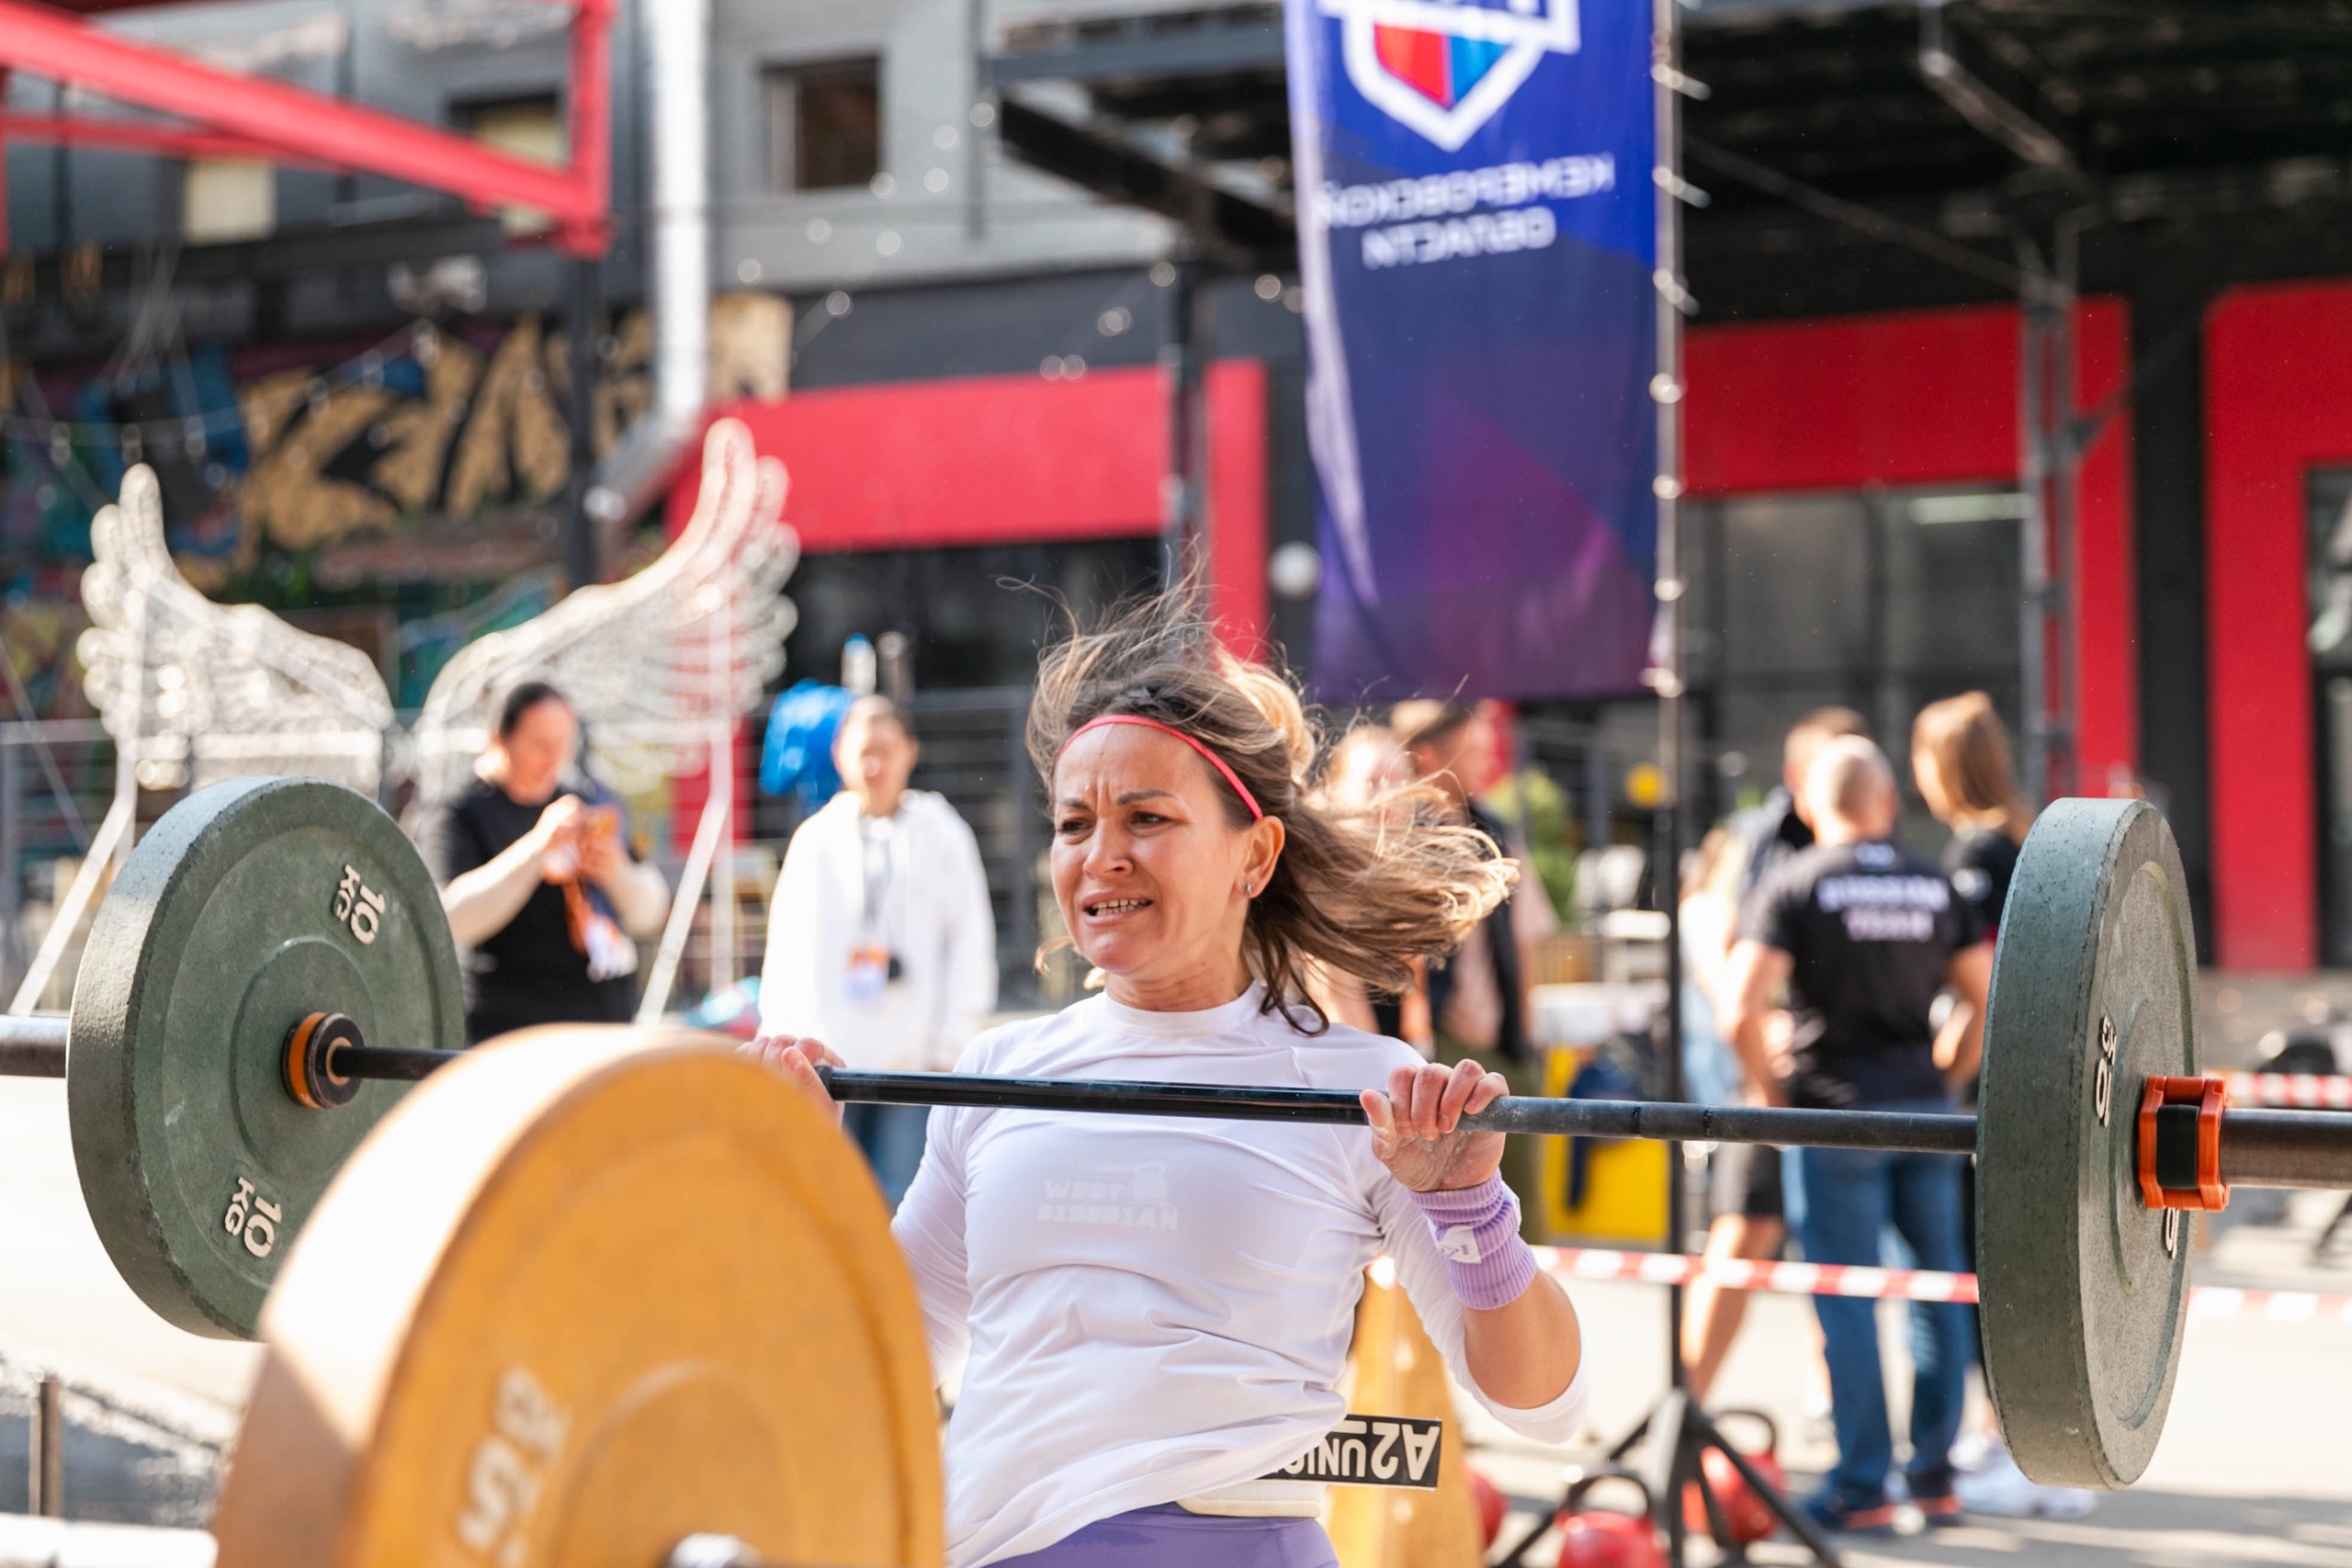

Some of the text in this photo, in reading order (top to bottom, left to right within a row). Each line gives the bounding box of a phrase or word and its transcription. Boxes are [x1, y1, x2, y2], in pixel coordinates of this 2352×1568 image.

[350, 884, 386, 945] 10
[2096, 1057, 2113, 1128] 10
[224, 1176, 255, 1236] KG
[243, 1195, 282, 1258] 10
